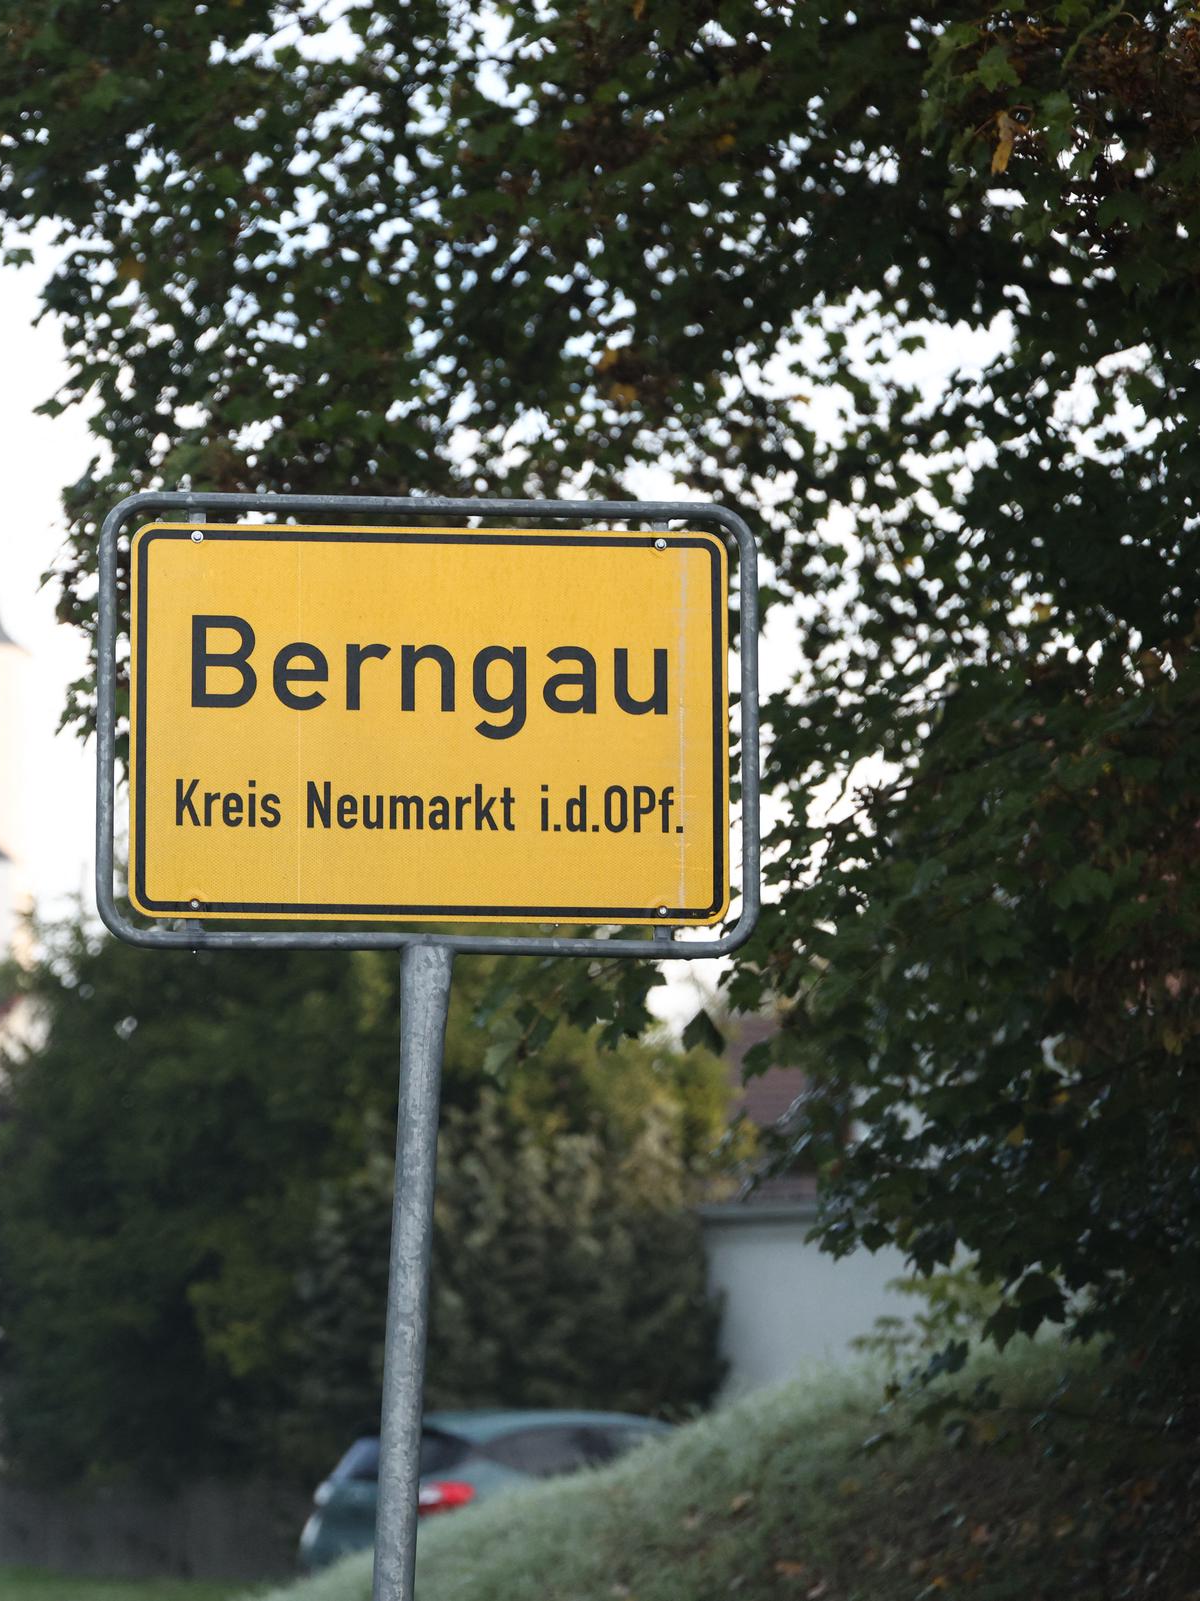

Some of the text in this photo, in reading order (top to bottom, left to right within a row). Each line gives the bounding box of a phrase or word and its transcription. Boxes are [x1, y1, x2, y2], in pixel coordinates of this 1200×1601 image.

[191, 614, 668, 740] Berngau
[175, 778, 684, 834] Kreis Neumarkt i.d.OPf.
